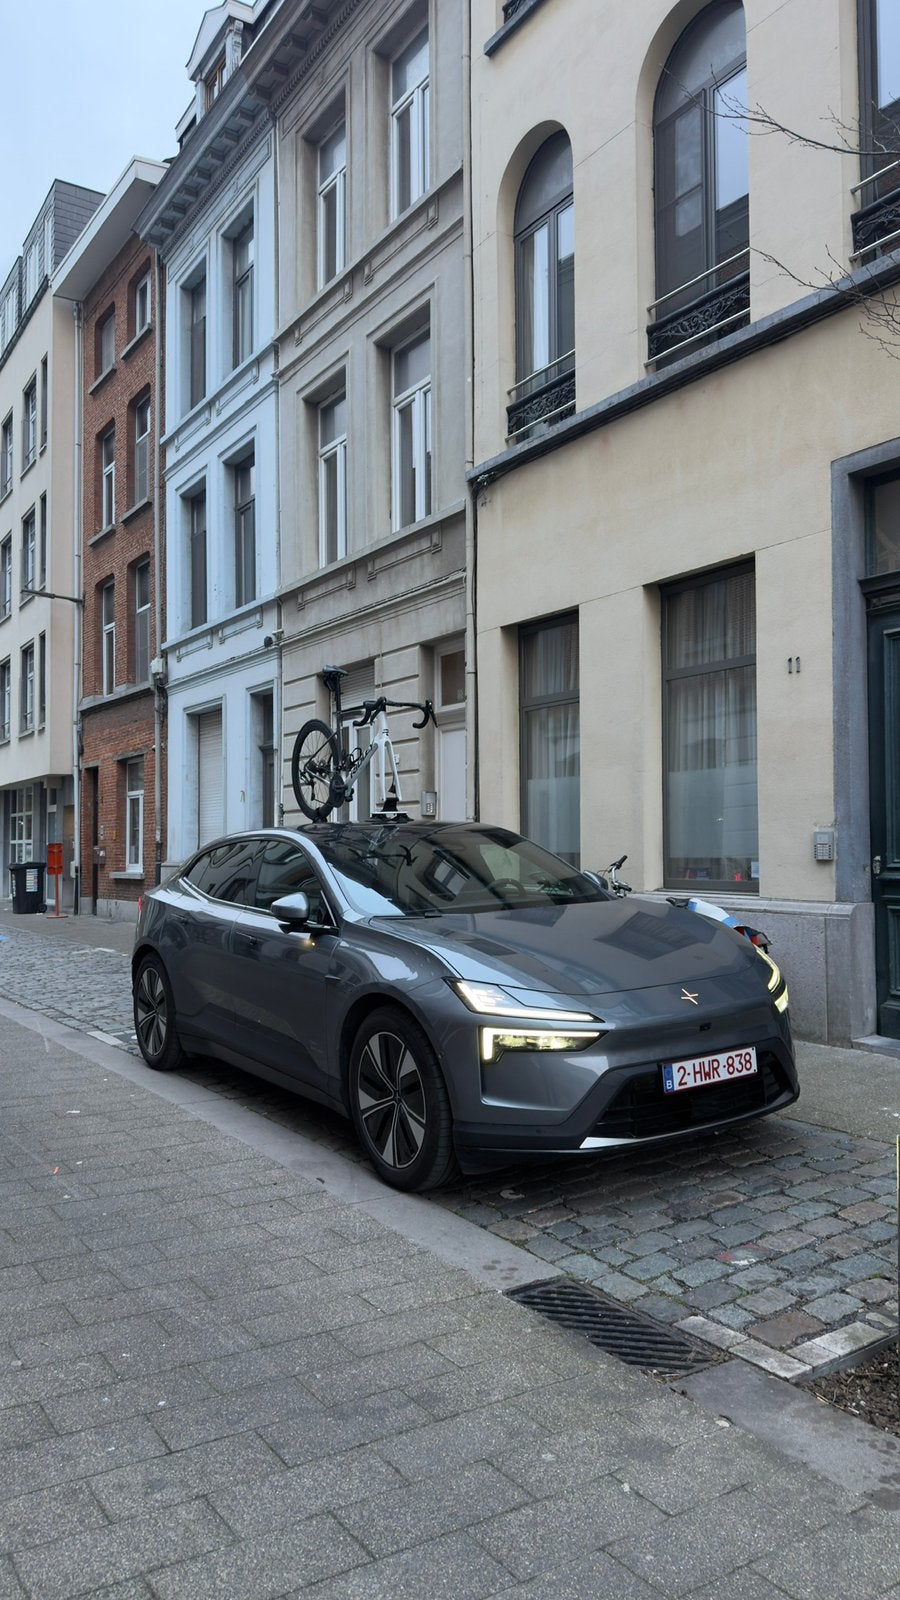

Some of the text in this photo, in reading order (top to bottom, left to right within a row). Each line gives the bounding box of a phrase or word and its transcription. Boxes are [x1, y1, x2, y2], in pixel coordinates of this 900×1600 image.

[787, 656, 801, 674] 11
[677, 1052, 753, 1087] 2-HWR-838
[666, 1080, 673, 1090] B
